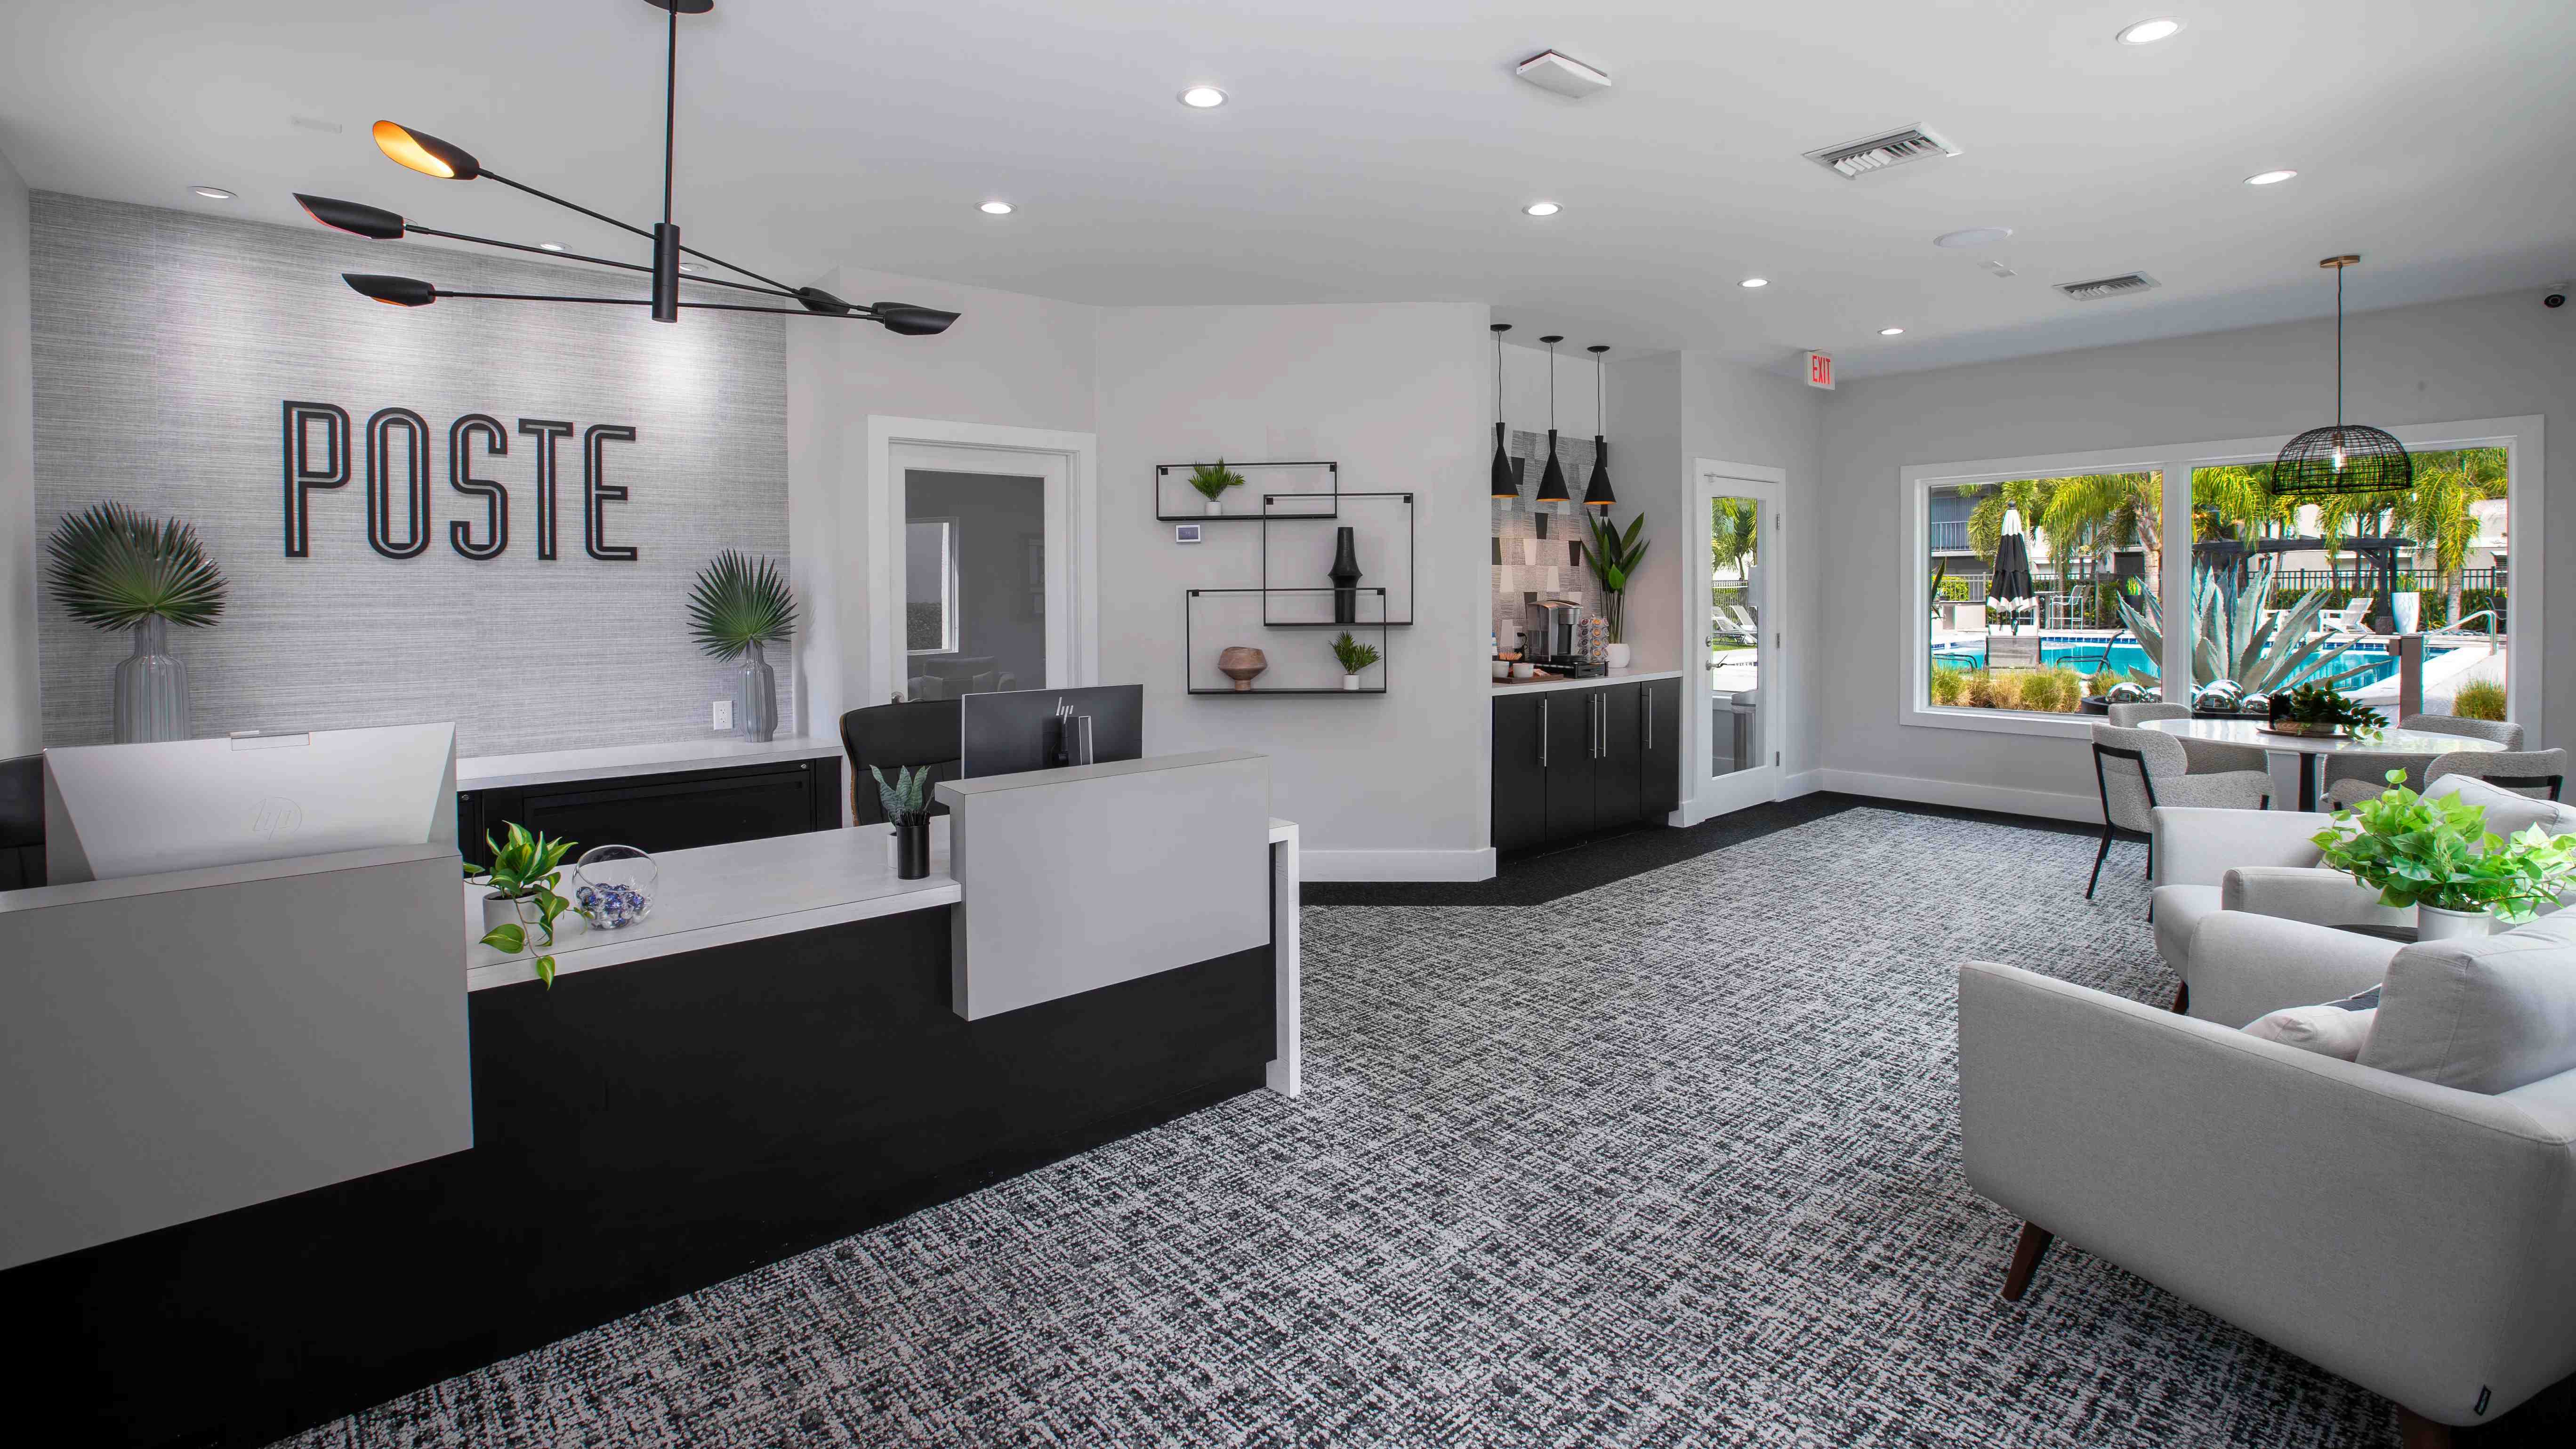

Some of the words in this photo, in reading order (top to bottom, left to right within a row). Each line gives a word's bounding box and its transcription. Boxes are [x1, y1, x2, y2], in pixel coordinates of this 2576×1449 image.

[1812, 354, 1831, 385] EXIT
[283, 400, 637, 561] POSTE
[1055, 697, 1074, 724] hp
